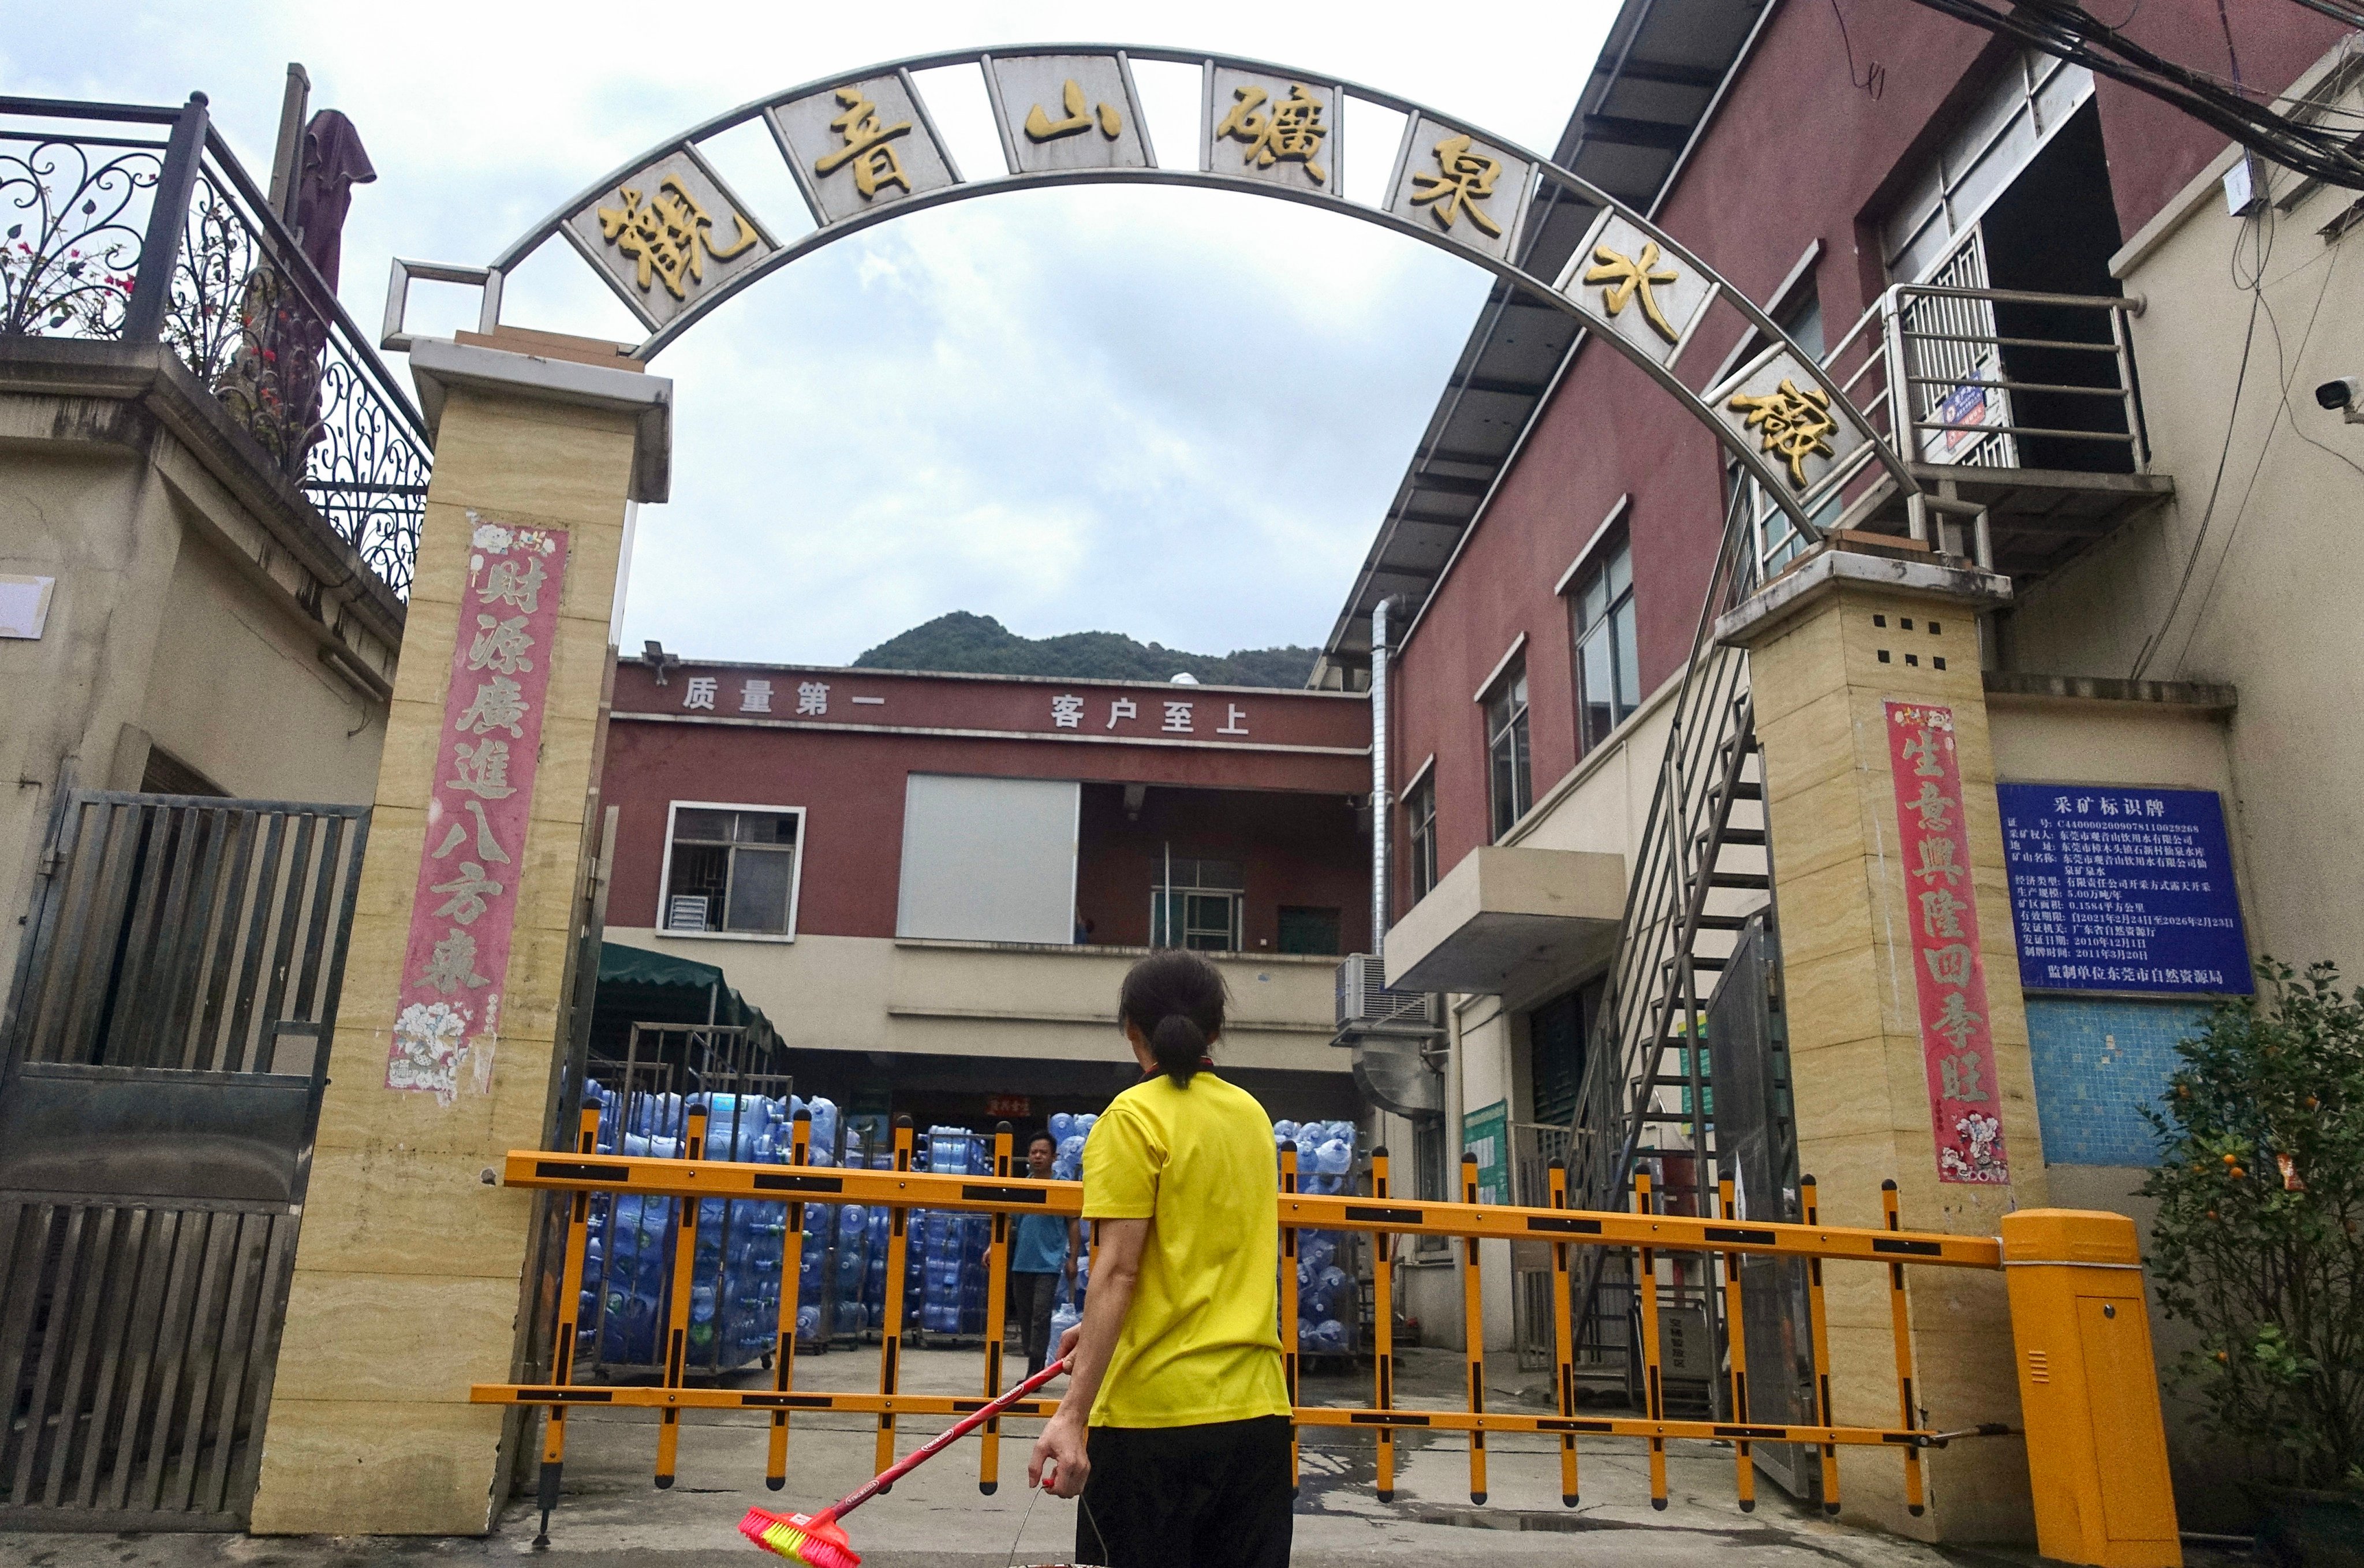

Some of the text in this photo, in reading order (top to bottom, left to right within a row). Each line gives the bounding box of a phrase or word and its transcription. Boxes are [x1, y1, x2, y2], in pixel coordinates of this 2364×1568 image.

[682, 677, 1250, 737] 质量第一 客户至上
[2052, 795, 2165, 817] 采矿标识牌
[1902, 729, 1990, 1105] 生意興隆四季旺
[2047, 964, 2223, 984] 监制单位东莞市自然资源局
